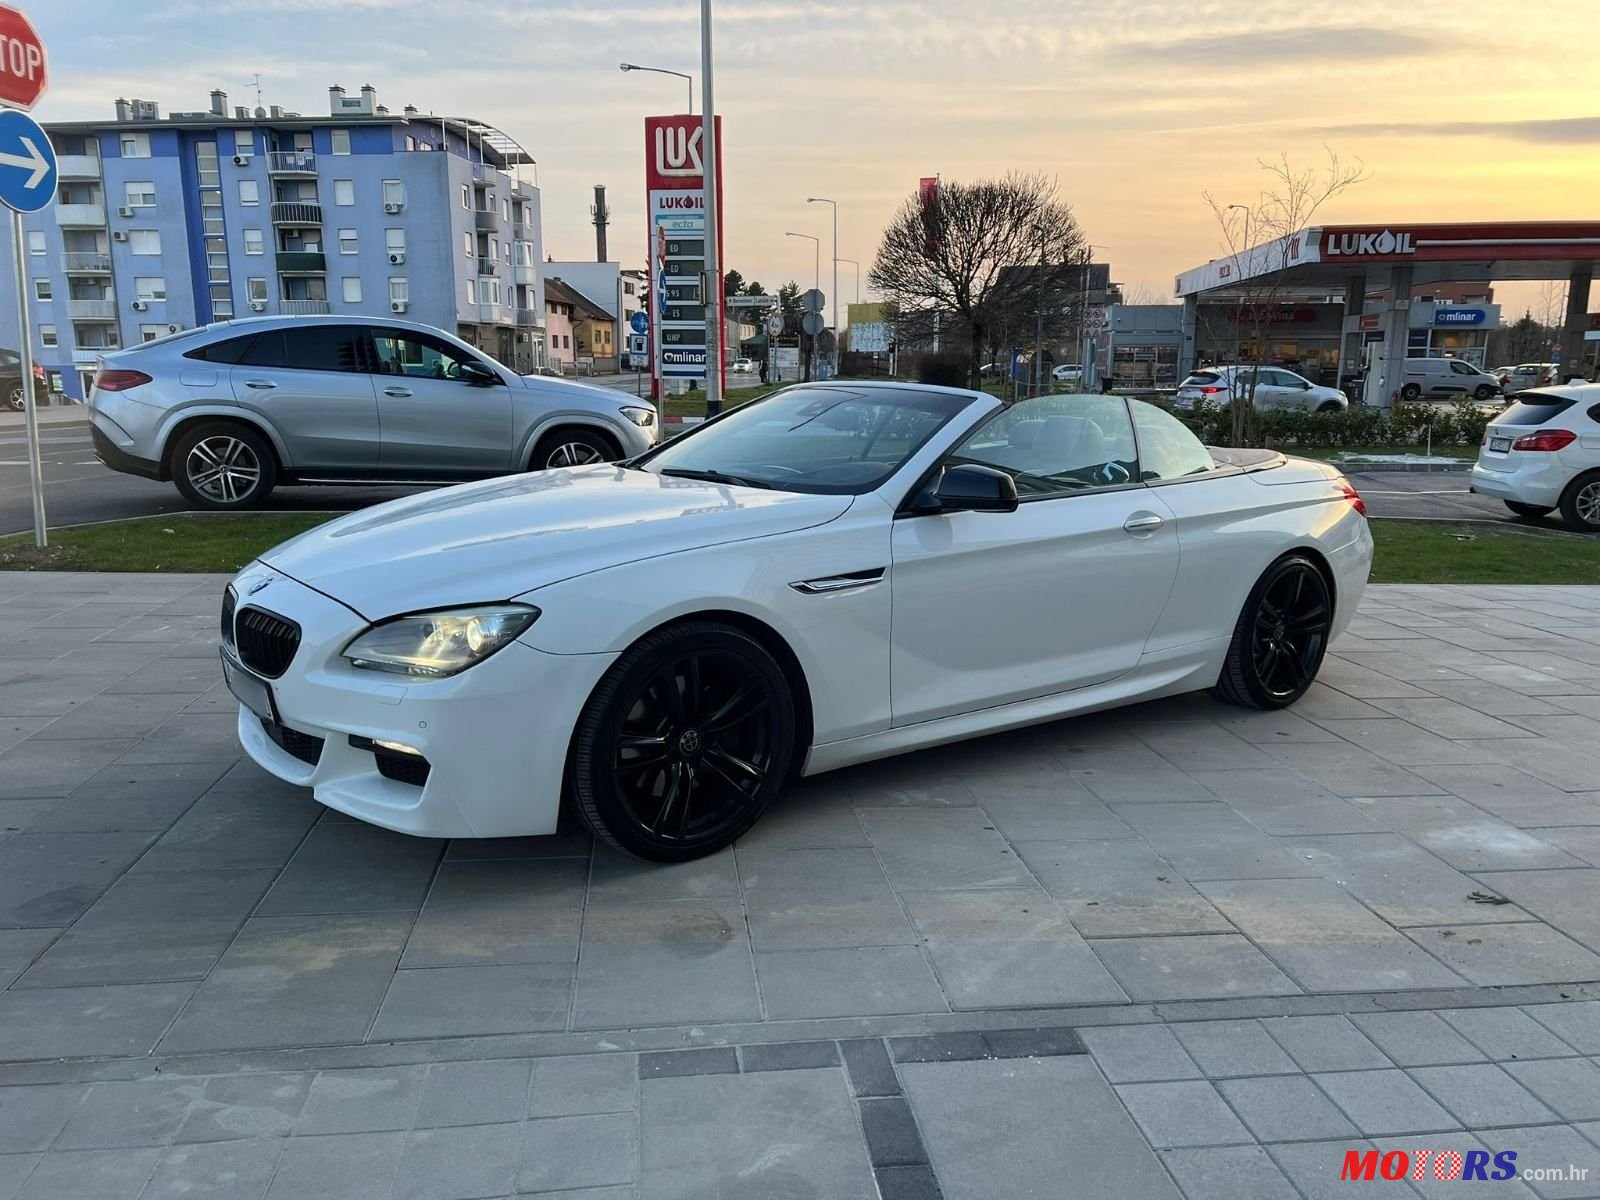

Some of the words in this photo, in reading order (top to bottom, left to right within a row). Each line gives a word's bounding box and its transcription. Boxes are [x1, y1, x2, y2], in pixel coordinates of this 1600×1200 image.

[0, 34, 42, 81] TOP
[659, 195, 704, 209] LUKOIL
[1327, 229, 1416, 255] LUKOIL
[1446, 312, 1477, 321] mlinar
[673, 352, 706, 363] mlinar
